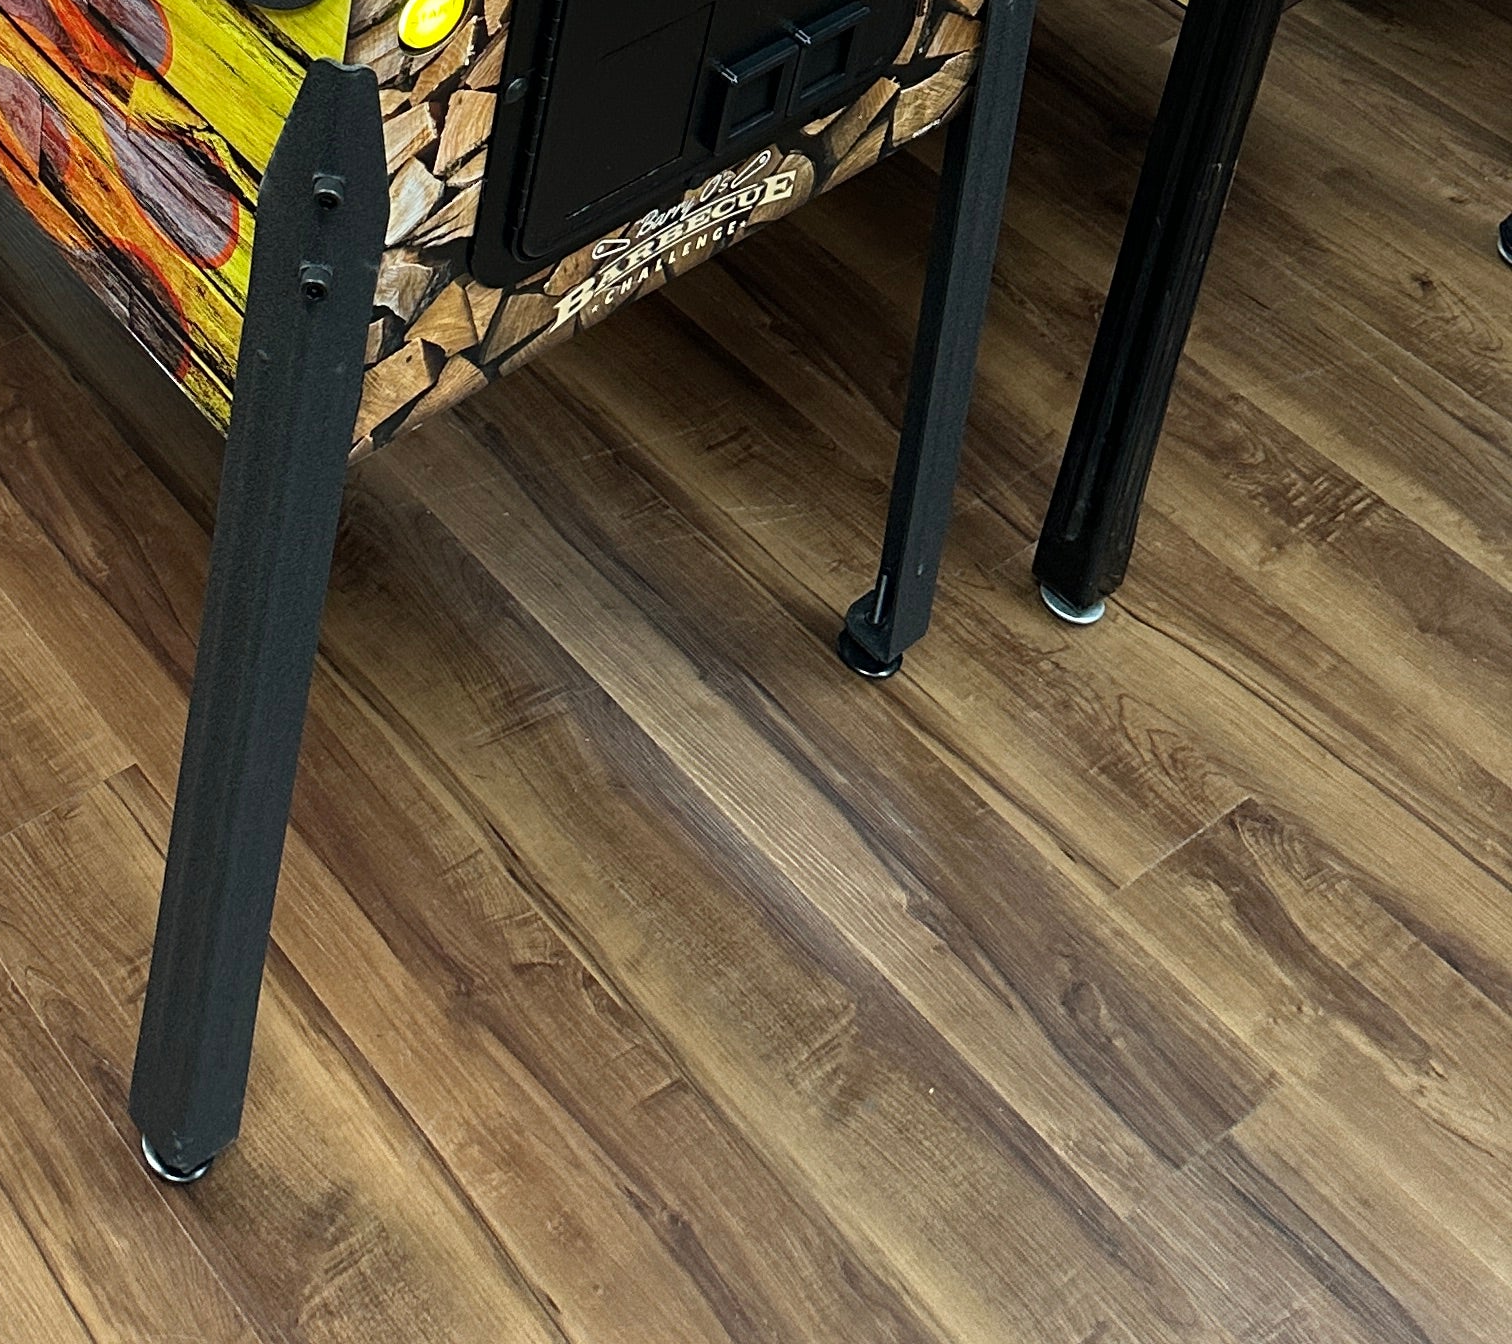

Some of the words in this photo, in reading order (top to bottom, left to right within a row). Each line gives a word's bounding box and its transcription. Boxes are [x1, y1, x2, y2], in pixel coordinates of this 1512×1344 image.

[635, 192, 696, 240] Barry
[699, 169, 732, 203] O's
[550, 169, 797, 331] BARBECUE
[604, 220, 737, 305] CHALLENGE
